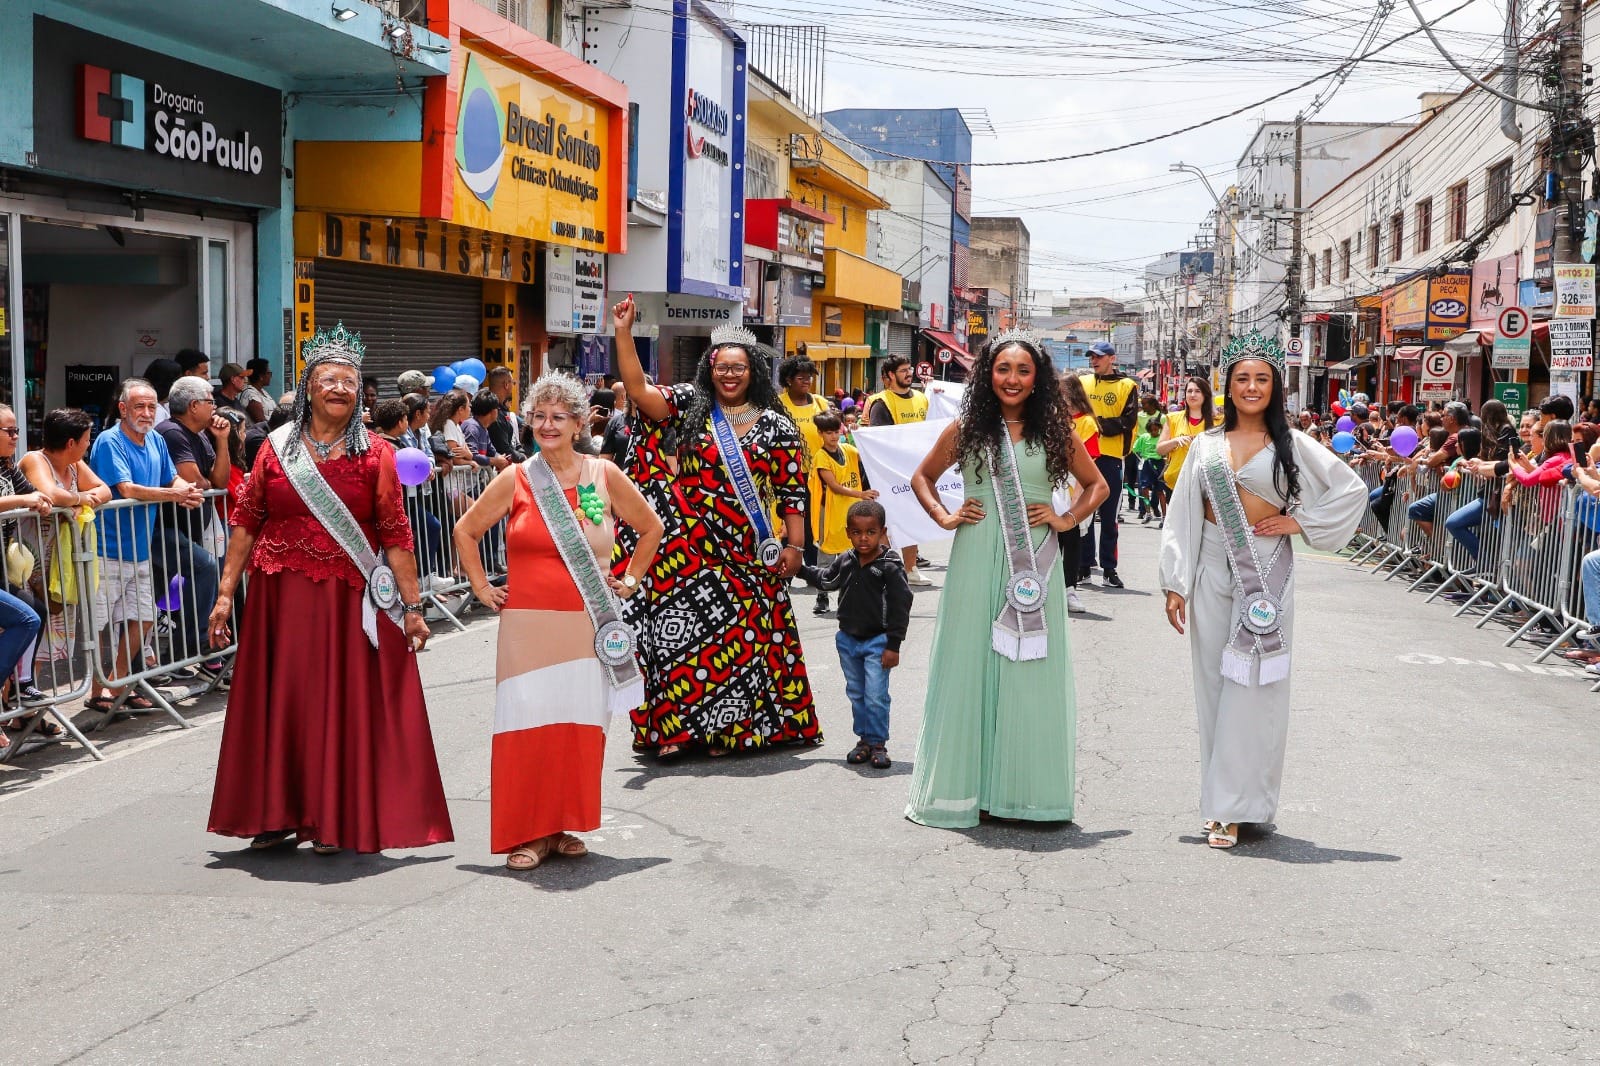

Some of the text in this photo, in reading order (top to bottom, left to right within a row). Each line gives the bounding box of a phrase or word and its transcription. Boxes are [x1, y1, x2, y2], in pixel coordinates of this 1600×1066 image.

[154, 84, 204, 115] Drogaria
[507, 102, 600, 171] Brasil Sorriso
[326, 216, 531, 281] DENTISTAS
[668, 308, 730, 319] DENTISTAS
[1507, 314, 1519, 331] E
[1434, 357, 1445, 371] E
[68, 371, 113, 381] PRINCIPIA
[730, 458, 744, 478] ALTO
[892, 484, 911, 494] Club
